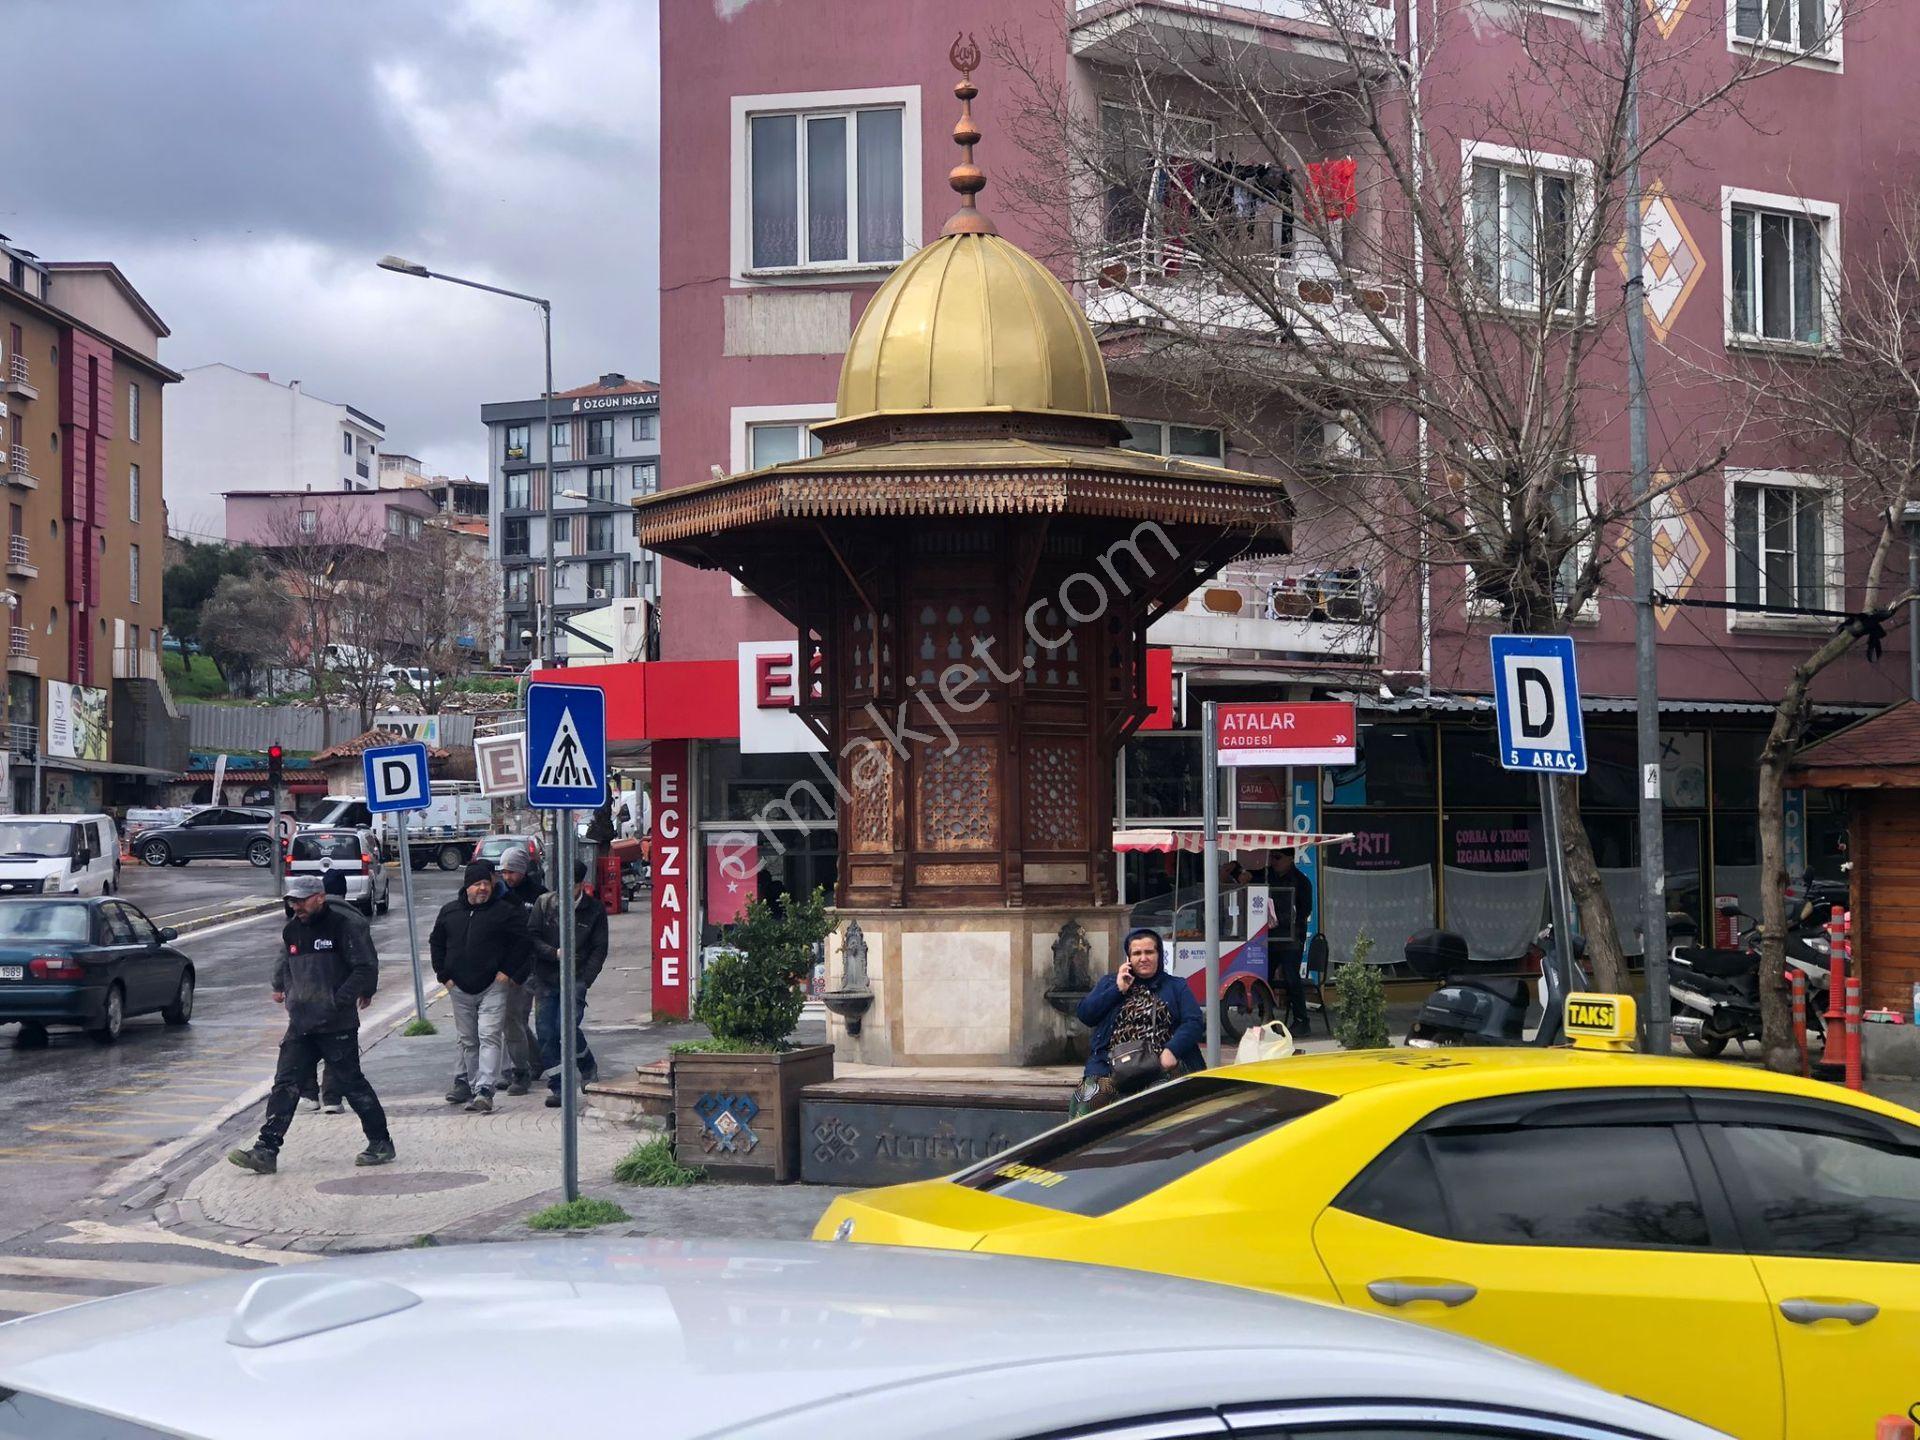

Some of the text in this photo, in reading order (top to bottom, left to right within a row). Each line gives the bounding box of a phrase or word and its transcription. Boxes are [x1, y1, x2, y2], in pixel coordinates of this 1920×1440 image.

[584, 396, 619, 409] ÖZGÜN
[1516, 667, 1555, 739] D
[1223, 712, 1296, 731] ATALAR
[1222, 734, 1272, 746] CADDESİ
[489, 748, 519, 785] E
[1510, 751, 1577, 771] 5 ARAÇ
[382, 760, 412, 796] D
[1339, 831, 1390, 856] ARTI
[1456, 830, 1488, 847] ÇORBA
[1500, 829, 1531, 843] YEMEK
[1457, 848, 1531, 863] IZGARA SALONU
[659, 774, 681, 986] ECZANE
[2, 967, 21, 977] 1989
[875, 1132, 1009, 1160] ALTIEYLÜ
